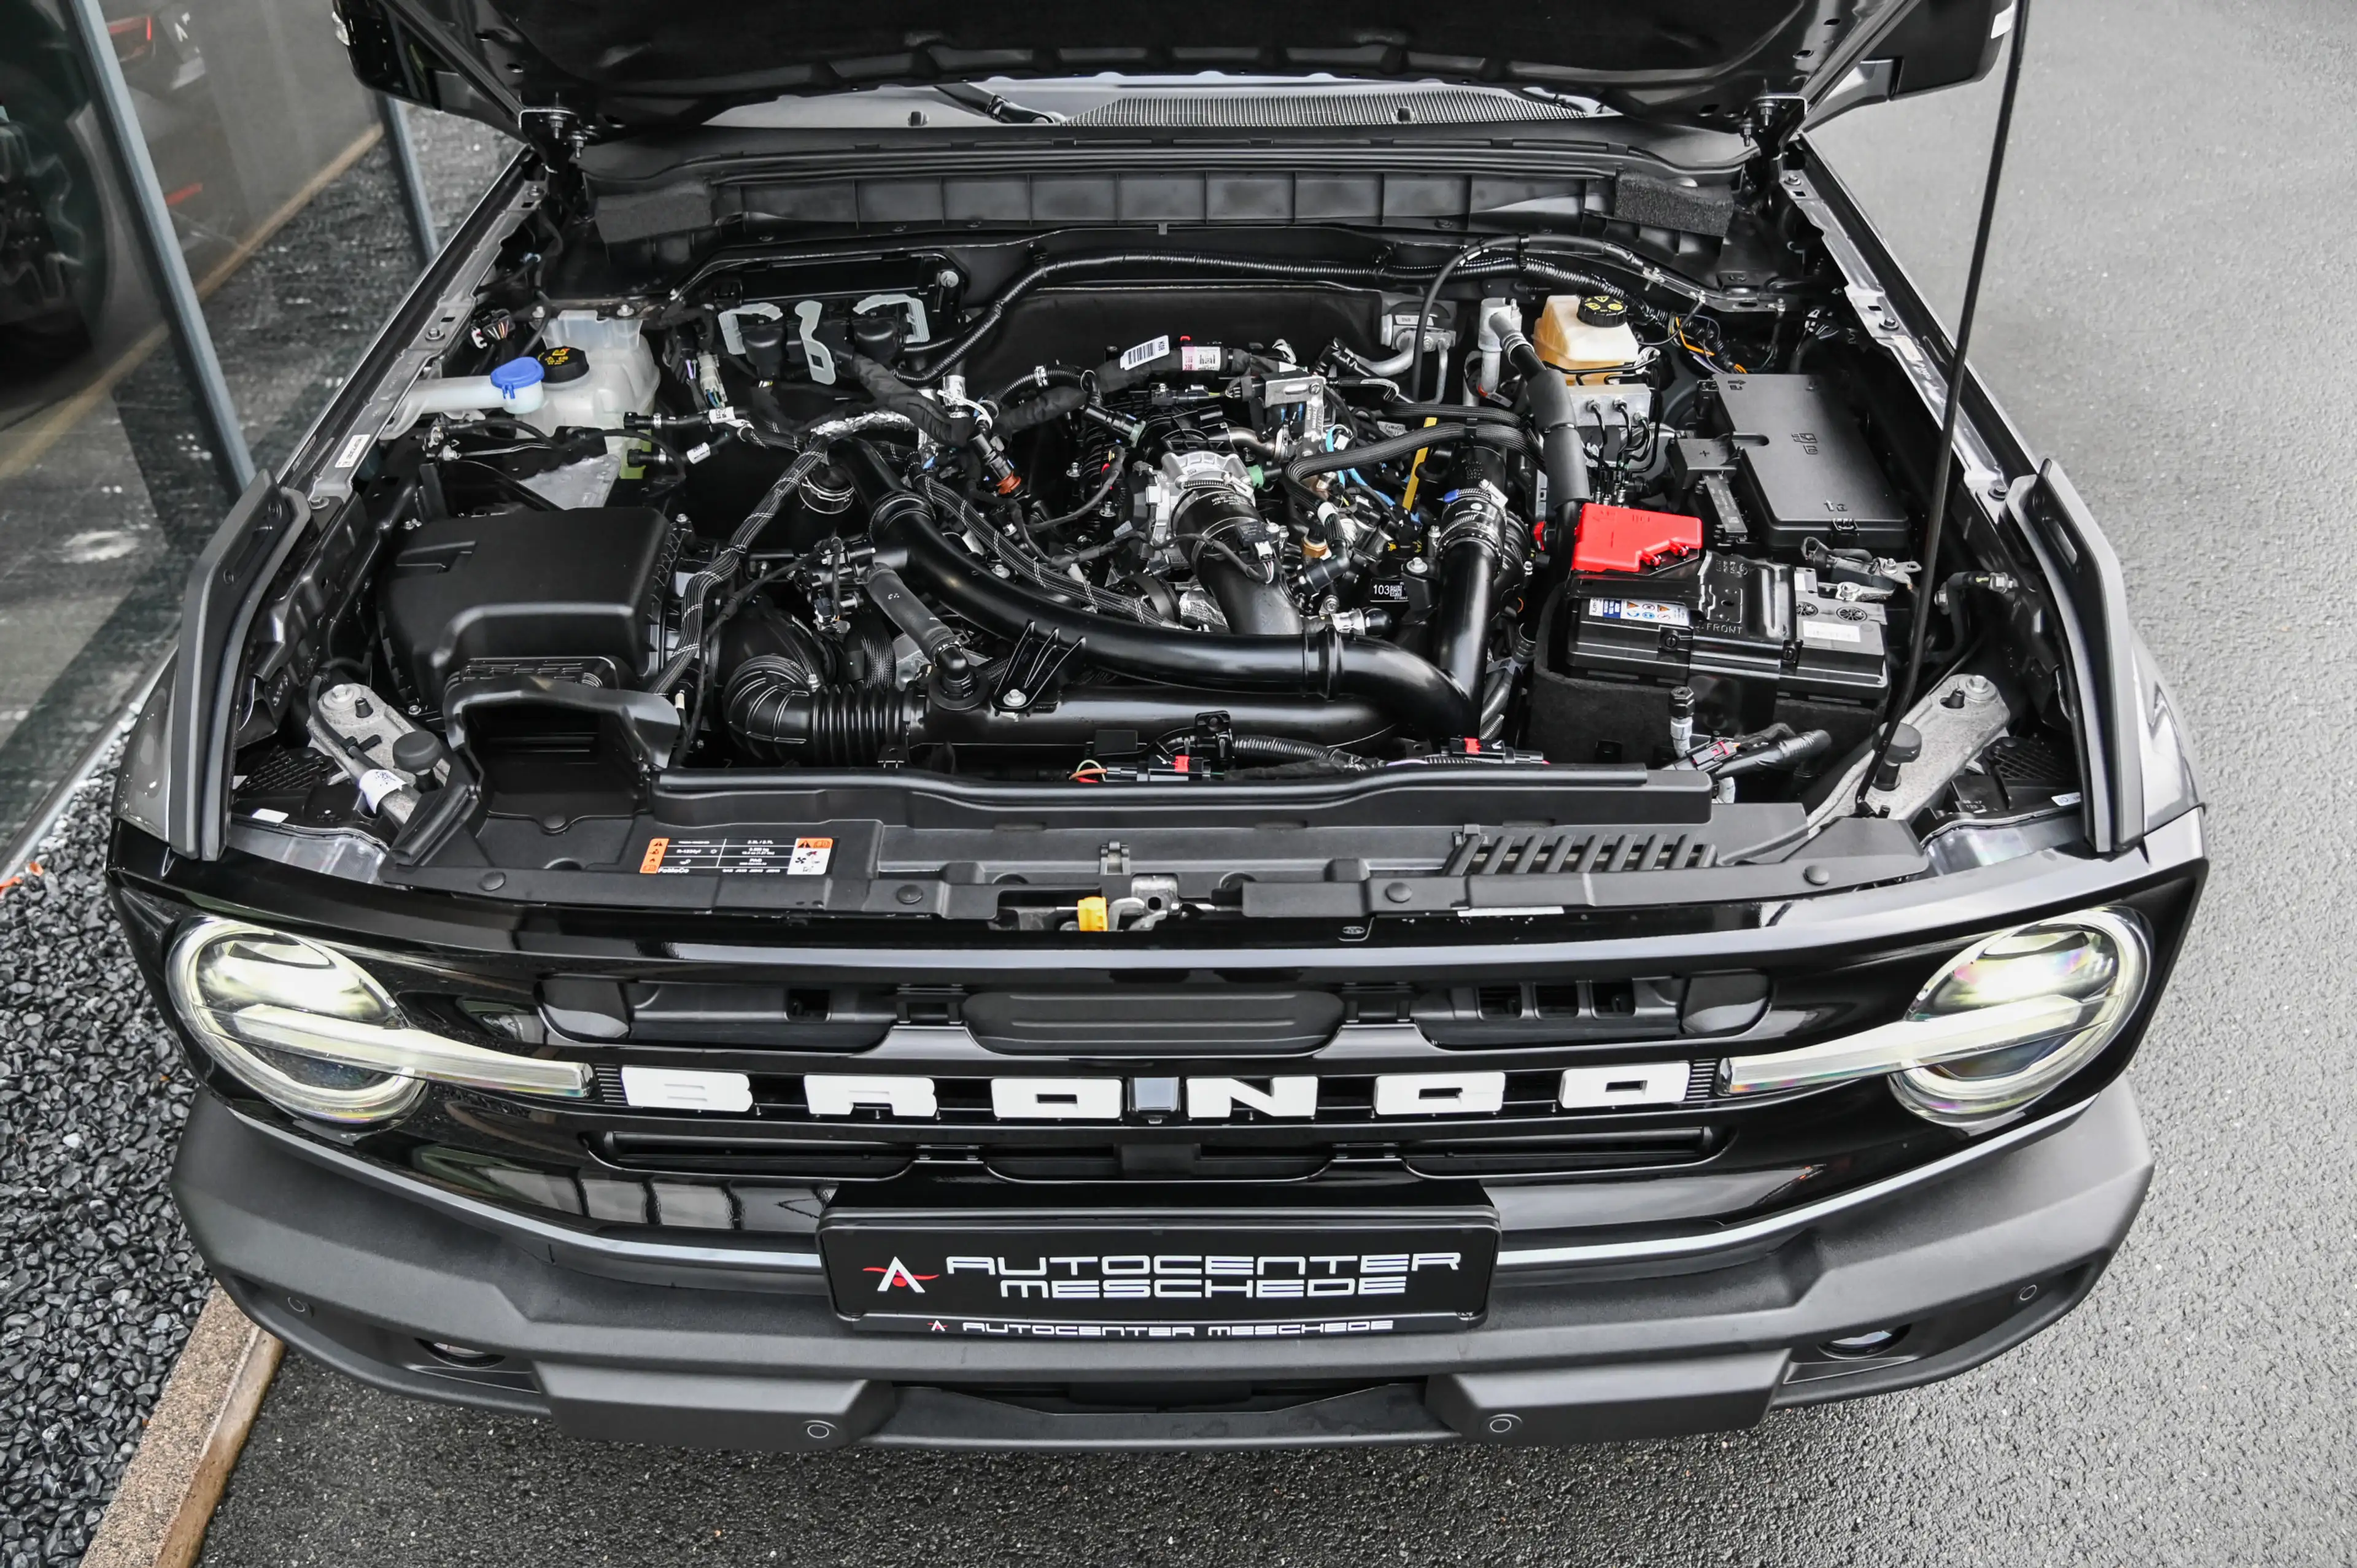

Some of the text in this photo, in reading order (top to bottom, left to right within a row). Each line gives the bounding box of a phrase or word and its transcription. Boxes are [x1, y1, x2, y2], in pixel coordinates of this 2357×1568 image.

[1373, 584, 1390, 595] 103
[1706, 623, 1743, 635] FRONT
[621, 1060, 1691, 1118] BRONCO
[945, 1252, 1461, 1276] AUTOCENTER
[1000, 1275, 1407, 1299] MESCHEDE
[962, 1319, 1394, 1337] AUTOCENTER MESCHEDE
